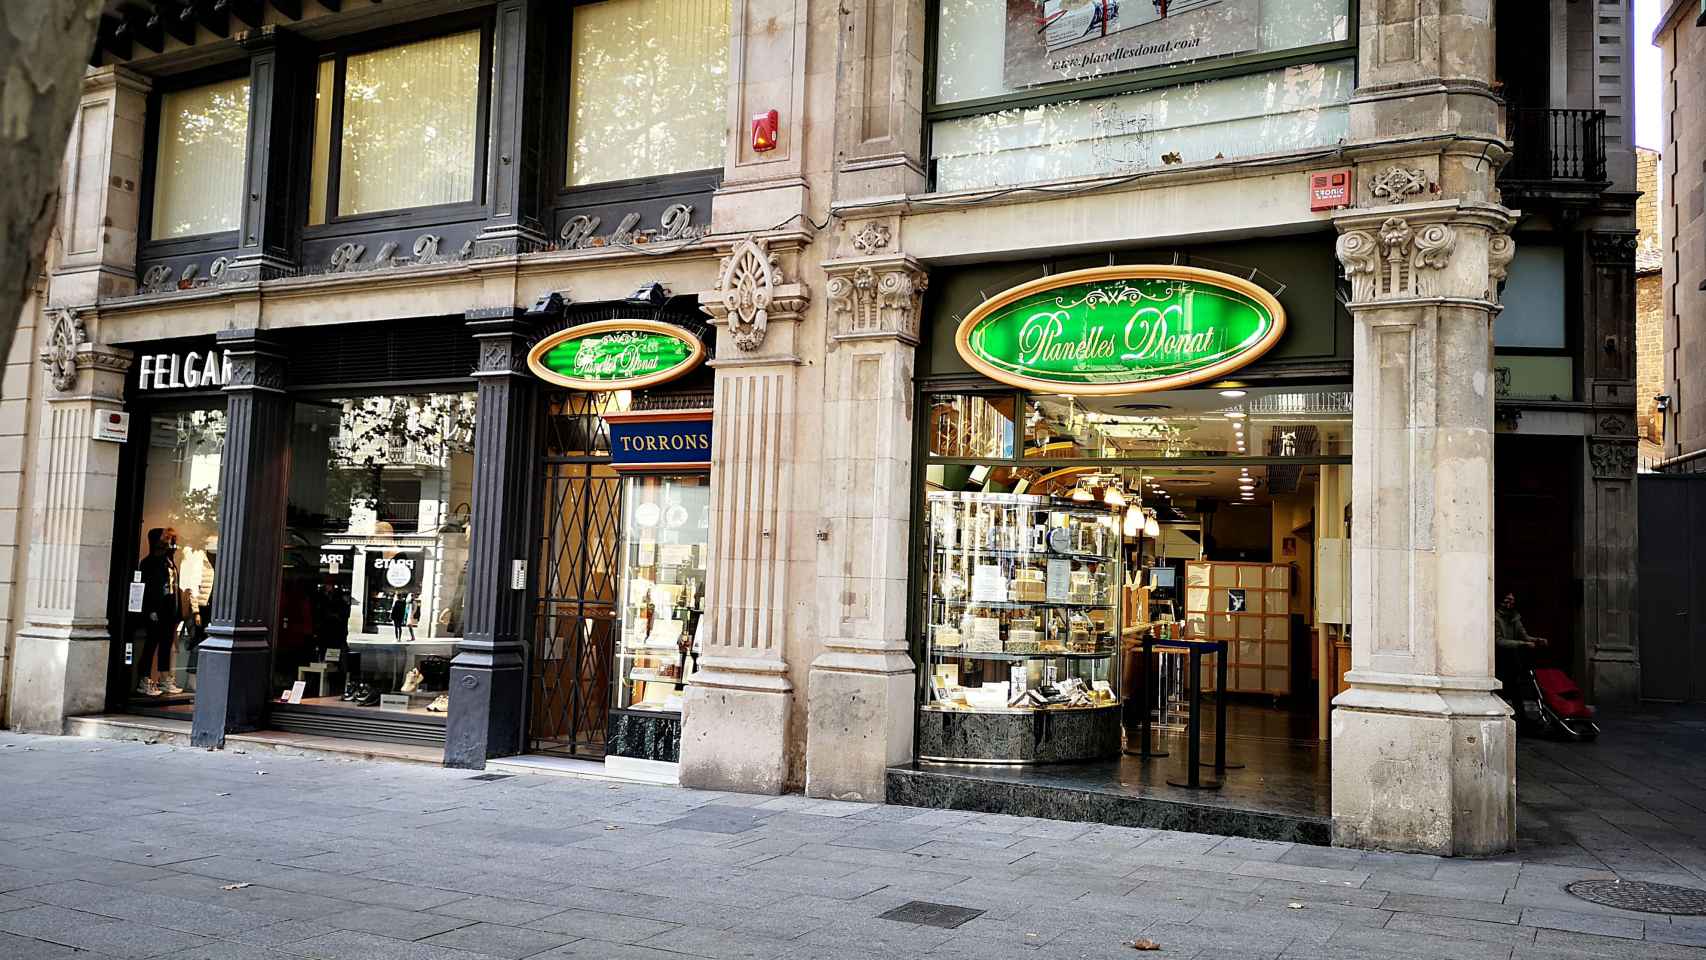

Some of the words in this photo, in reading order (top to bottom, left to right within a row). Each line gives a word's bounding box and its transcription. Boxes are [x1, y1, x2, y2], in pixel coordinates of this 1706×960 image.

[1018, 311, 1116, 365] Planelles
[1120, 304, 1215, 361] Donat
[620, 434, 709, 451] TORRONS
